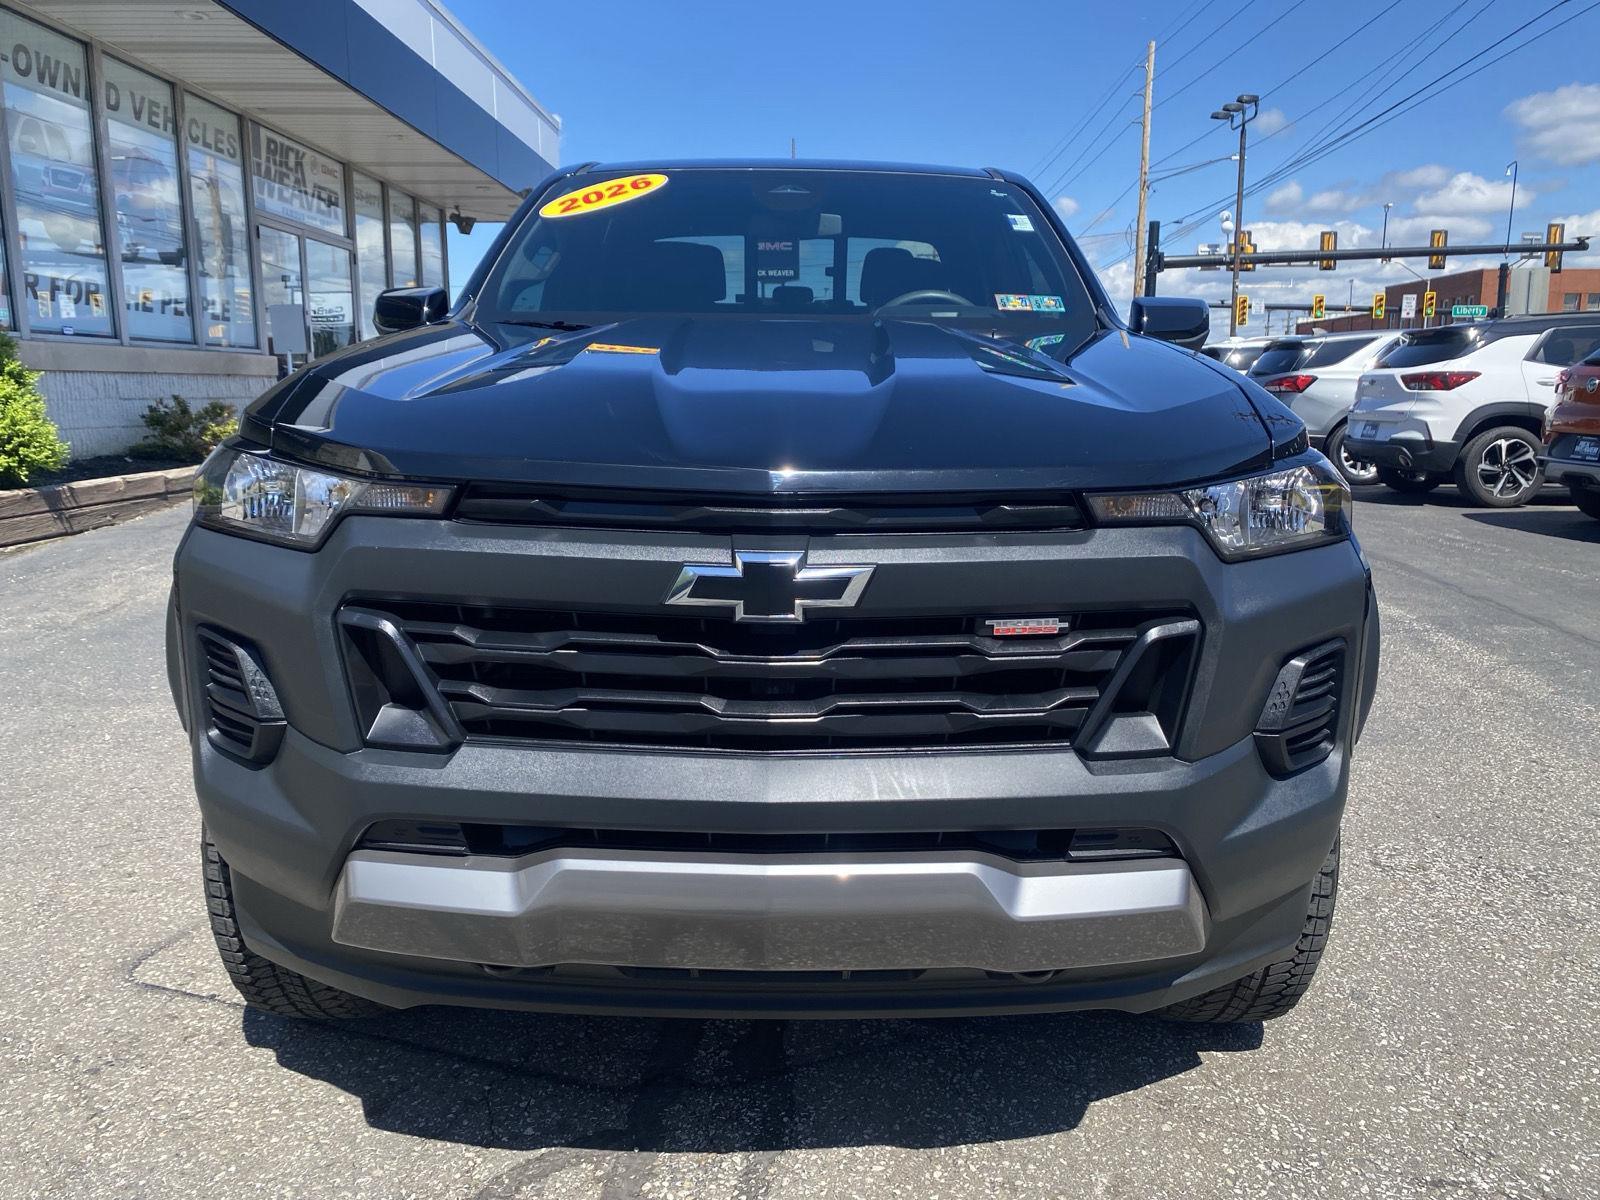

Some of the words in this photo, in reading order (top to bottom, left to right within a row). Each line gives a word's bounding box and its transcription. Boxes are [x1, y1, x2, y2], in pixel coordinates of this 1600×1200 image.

[129, 89, 237, 159] VEHCLES
[266, 135, 305, 174] RICK
[254, 160, 339, 220] WEAVER
[558, 177, 653, 213] 2026
[768, 269, 794, 277] WEAVER
[1456, 307, 1484, 316] Liberty
